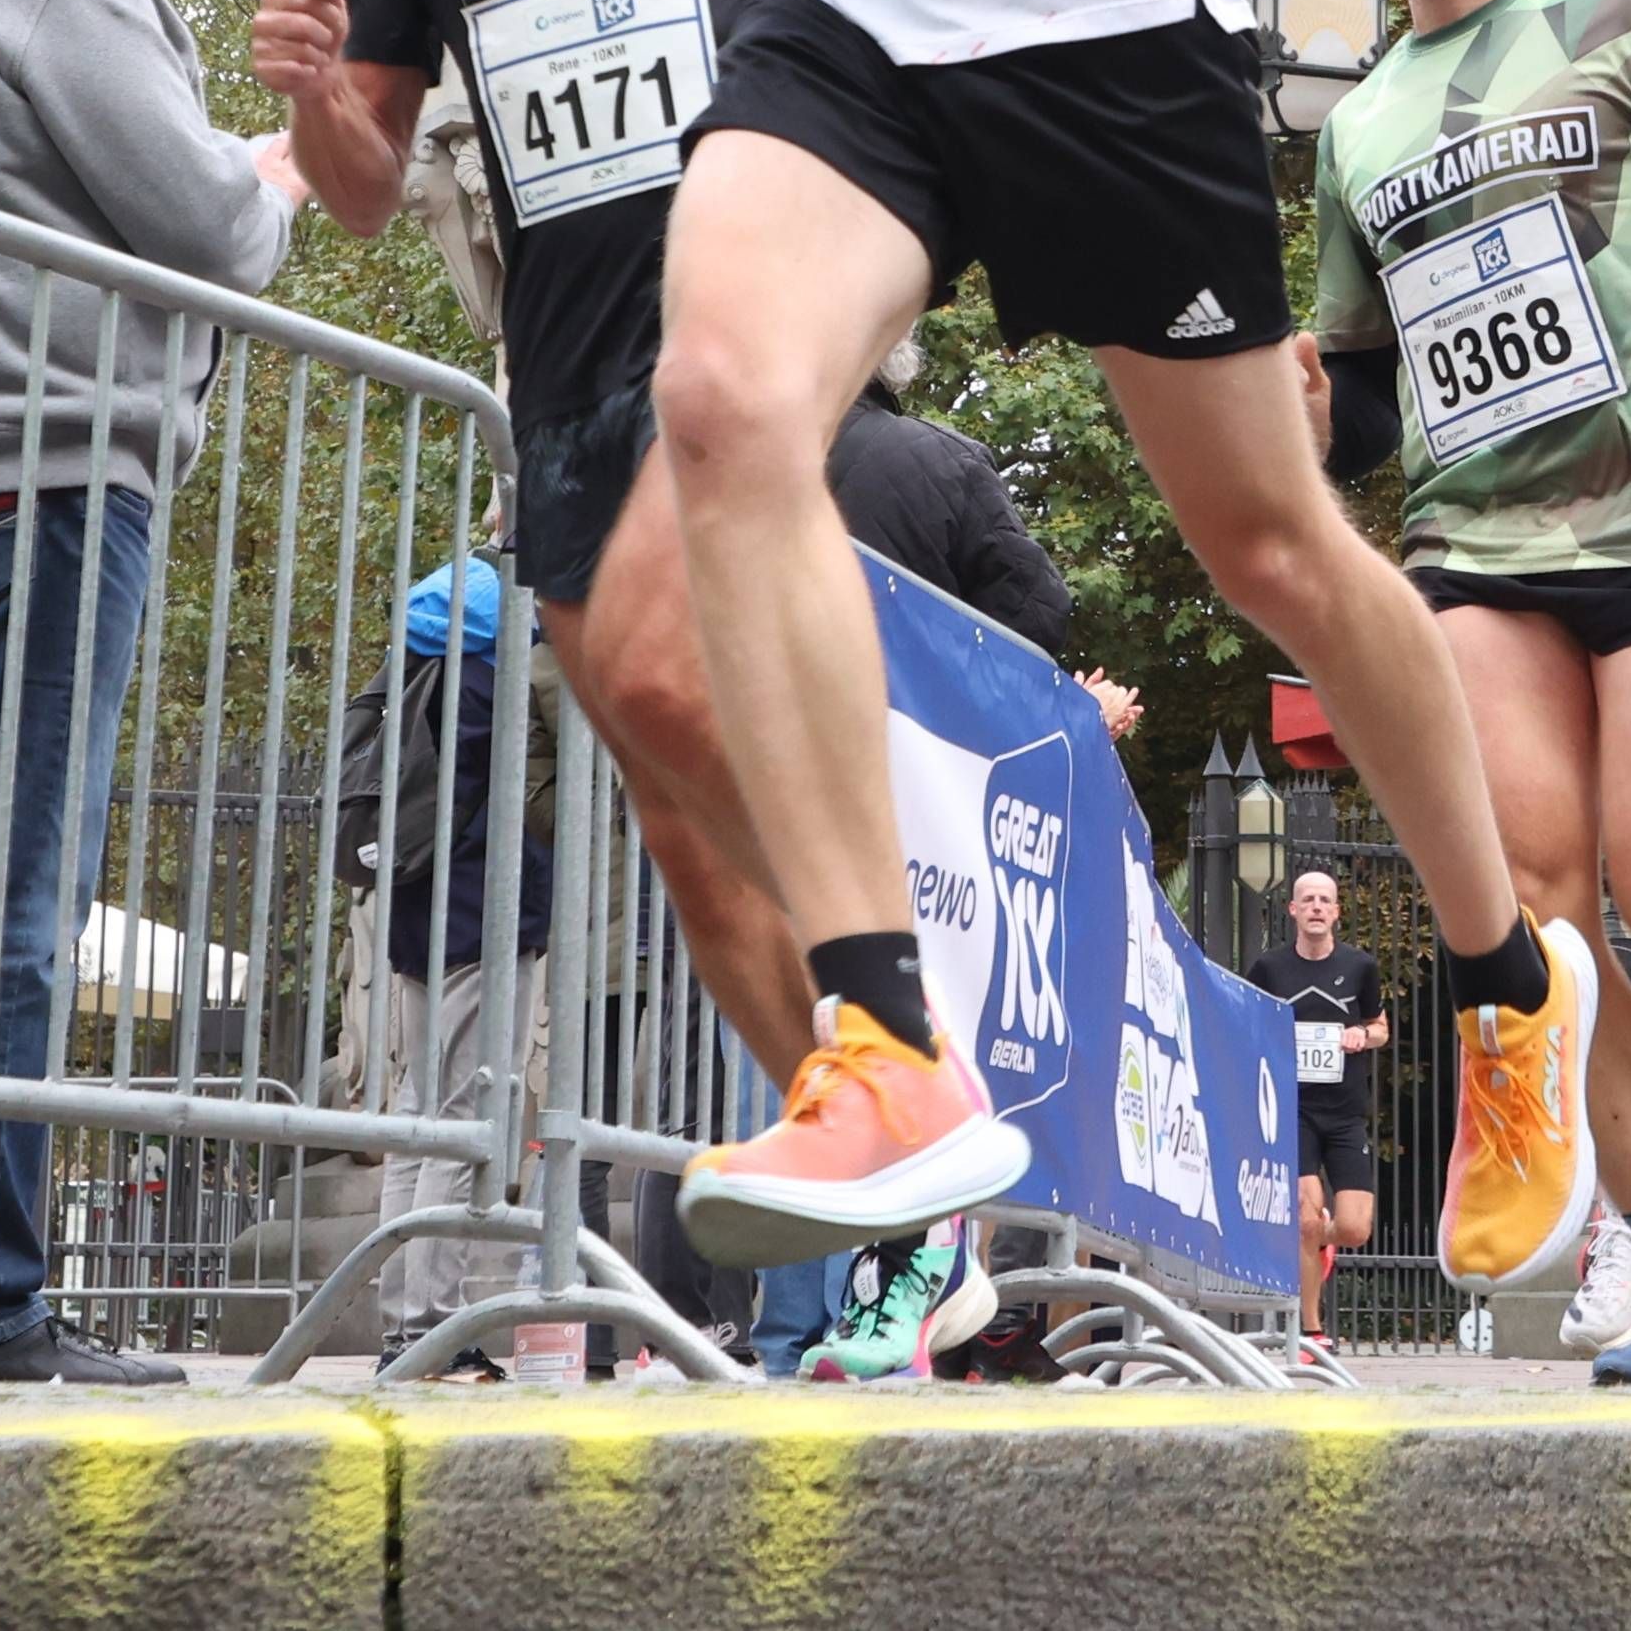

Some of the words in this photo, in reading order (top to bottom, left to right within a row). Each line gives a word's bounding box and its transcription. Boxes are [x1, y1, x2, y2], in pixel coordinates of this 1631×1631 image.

[593, 43, 627, 63] 10KM
[525, 56, 677, 160] 4171
[1166, 317, 1236, 339] adidas
[1433, 301, 1486, 331] Maximilian
[1494, 283, 1526, 305] 10KM
[1427, 297, 1572, 409] 9368
[990, 793, 1062, 879] GREAT
[989, 1038, 1036, 1075] BERLIN
[1300, 1049, 1333, 1068] 102
